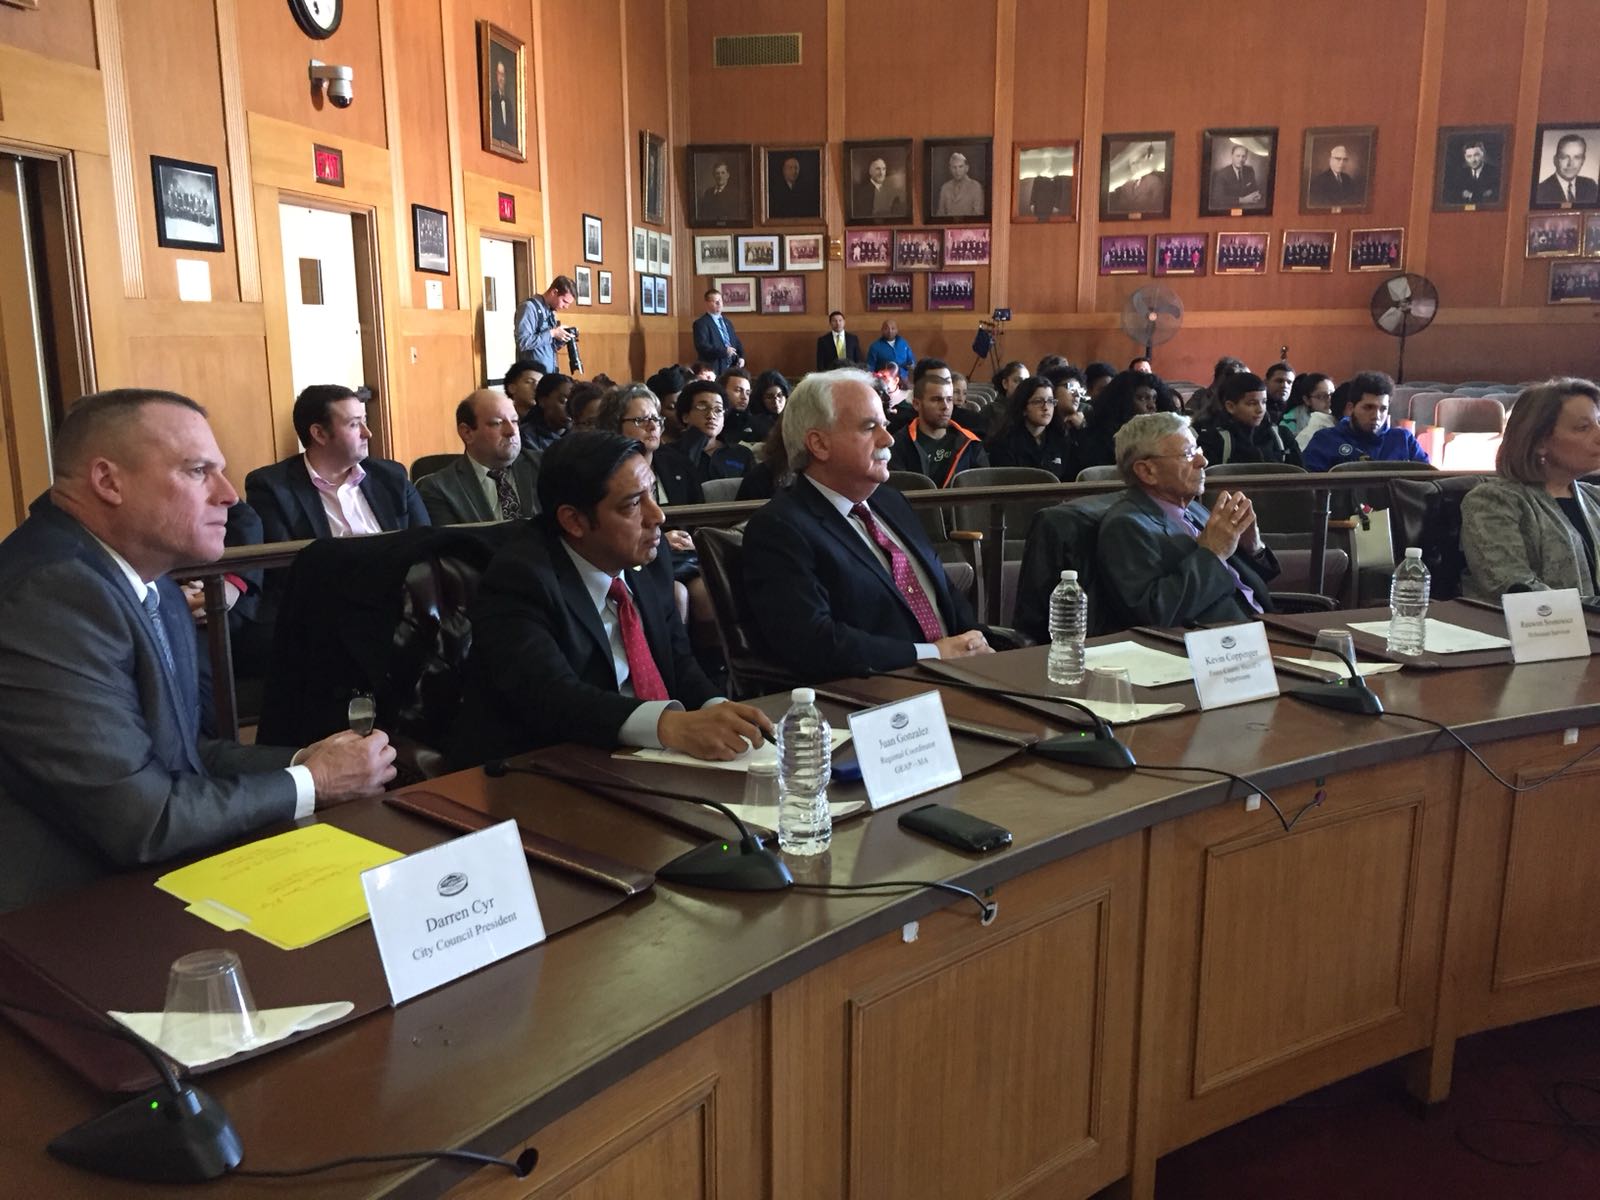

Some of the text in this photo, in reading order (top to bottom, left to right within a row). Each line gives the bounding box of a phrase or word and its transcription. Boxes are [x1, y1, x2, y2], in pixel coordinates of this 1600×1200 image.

[316, 151, 339, 179] EXIT
[878, 727, 929, 749] Juan Gonzalez
[425, 897, 495, 933] Darren Cyr
[411, 911, 518, 962] City Council President
